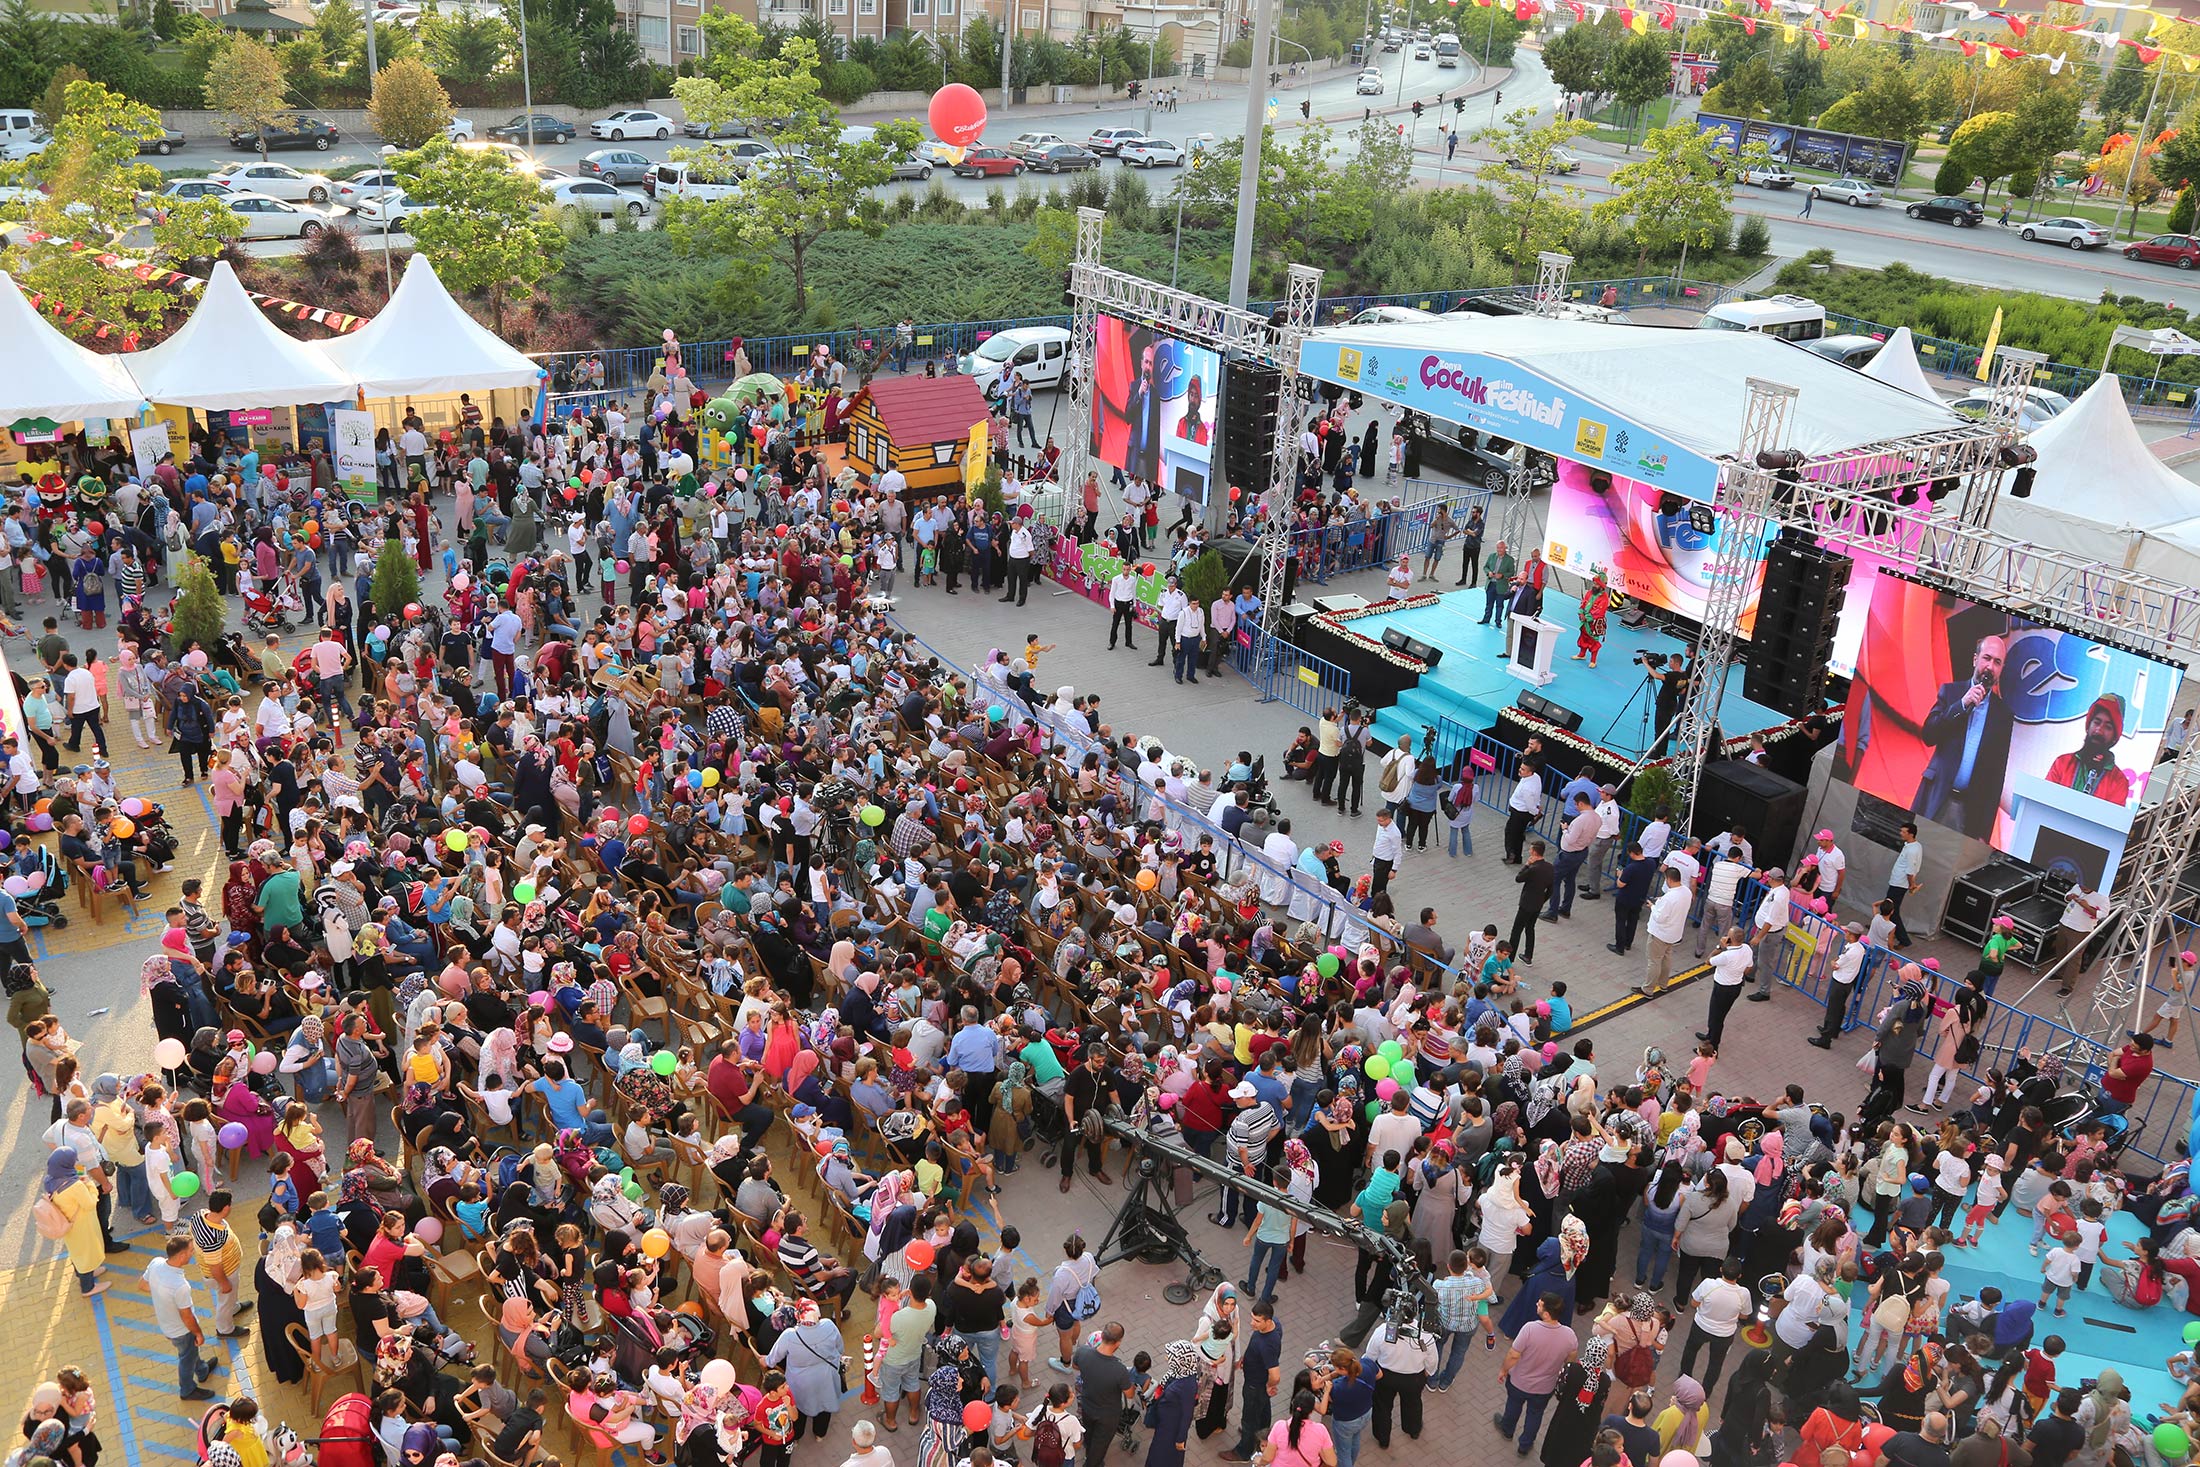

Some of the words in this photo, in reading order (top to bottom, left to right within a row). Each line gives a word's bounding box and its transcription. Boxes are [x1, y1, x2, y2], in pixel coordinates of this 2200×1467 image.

[1420, 355, 1488, 405] Çocuk
[1440, 360, 1462, 370] Konya
[1487, 380, 1567, 430] Festivali
[1703, 562, 1714, 572] 20
